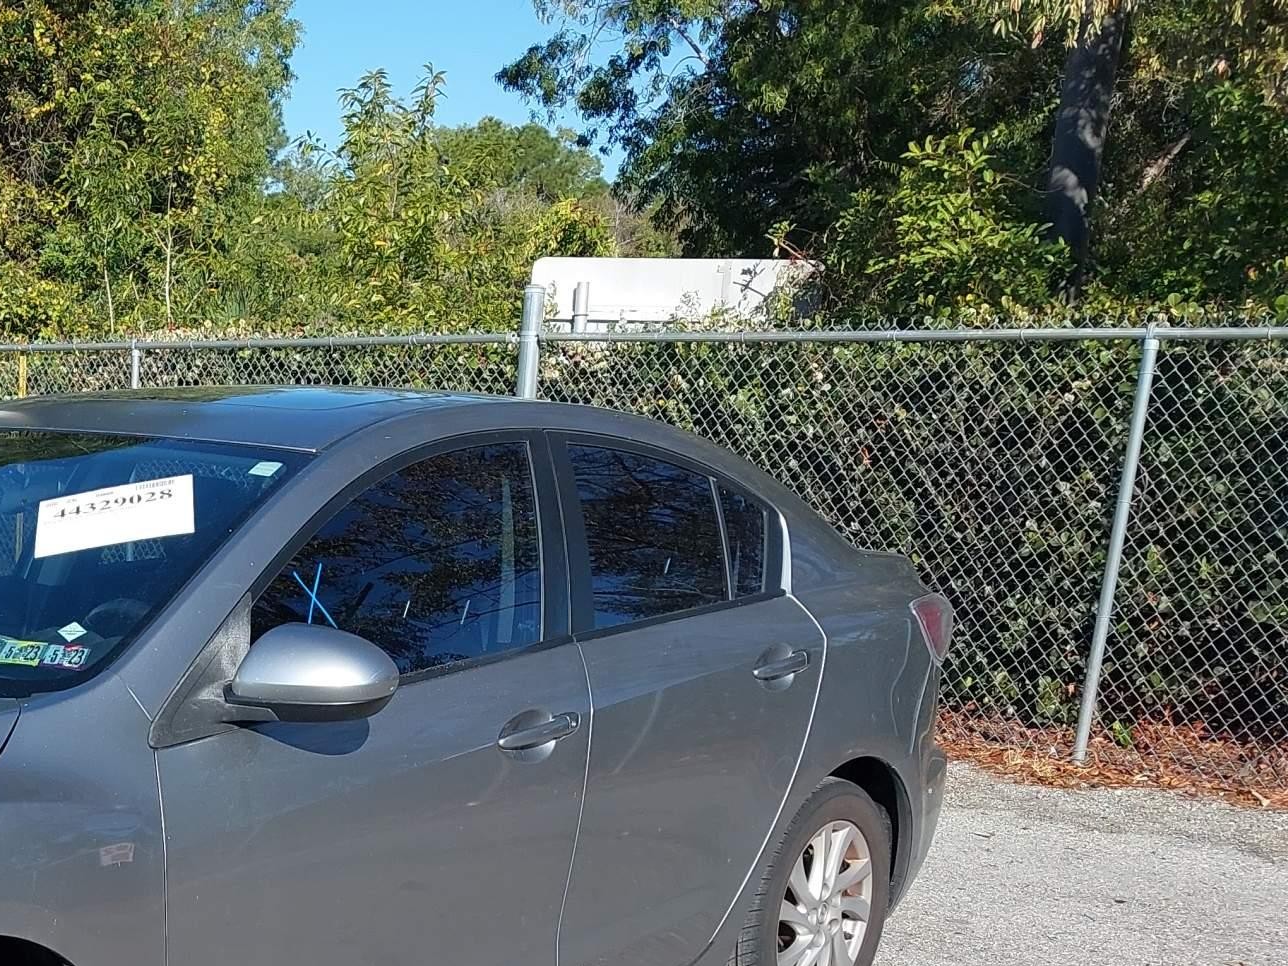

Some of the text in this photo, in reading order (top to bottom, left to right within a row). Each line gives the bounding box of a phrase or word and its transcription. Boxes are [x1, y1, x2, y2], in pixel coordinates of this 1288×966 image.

[53, 489, 173, 518] 44329028
[5, 645, 41, 661] 5 23
[50, 649, 85, 666] 5 23
